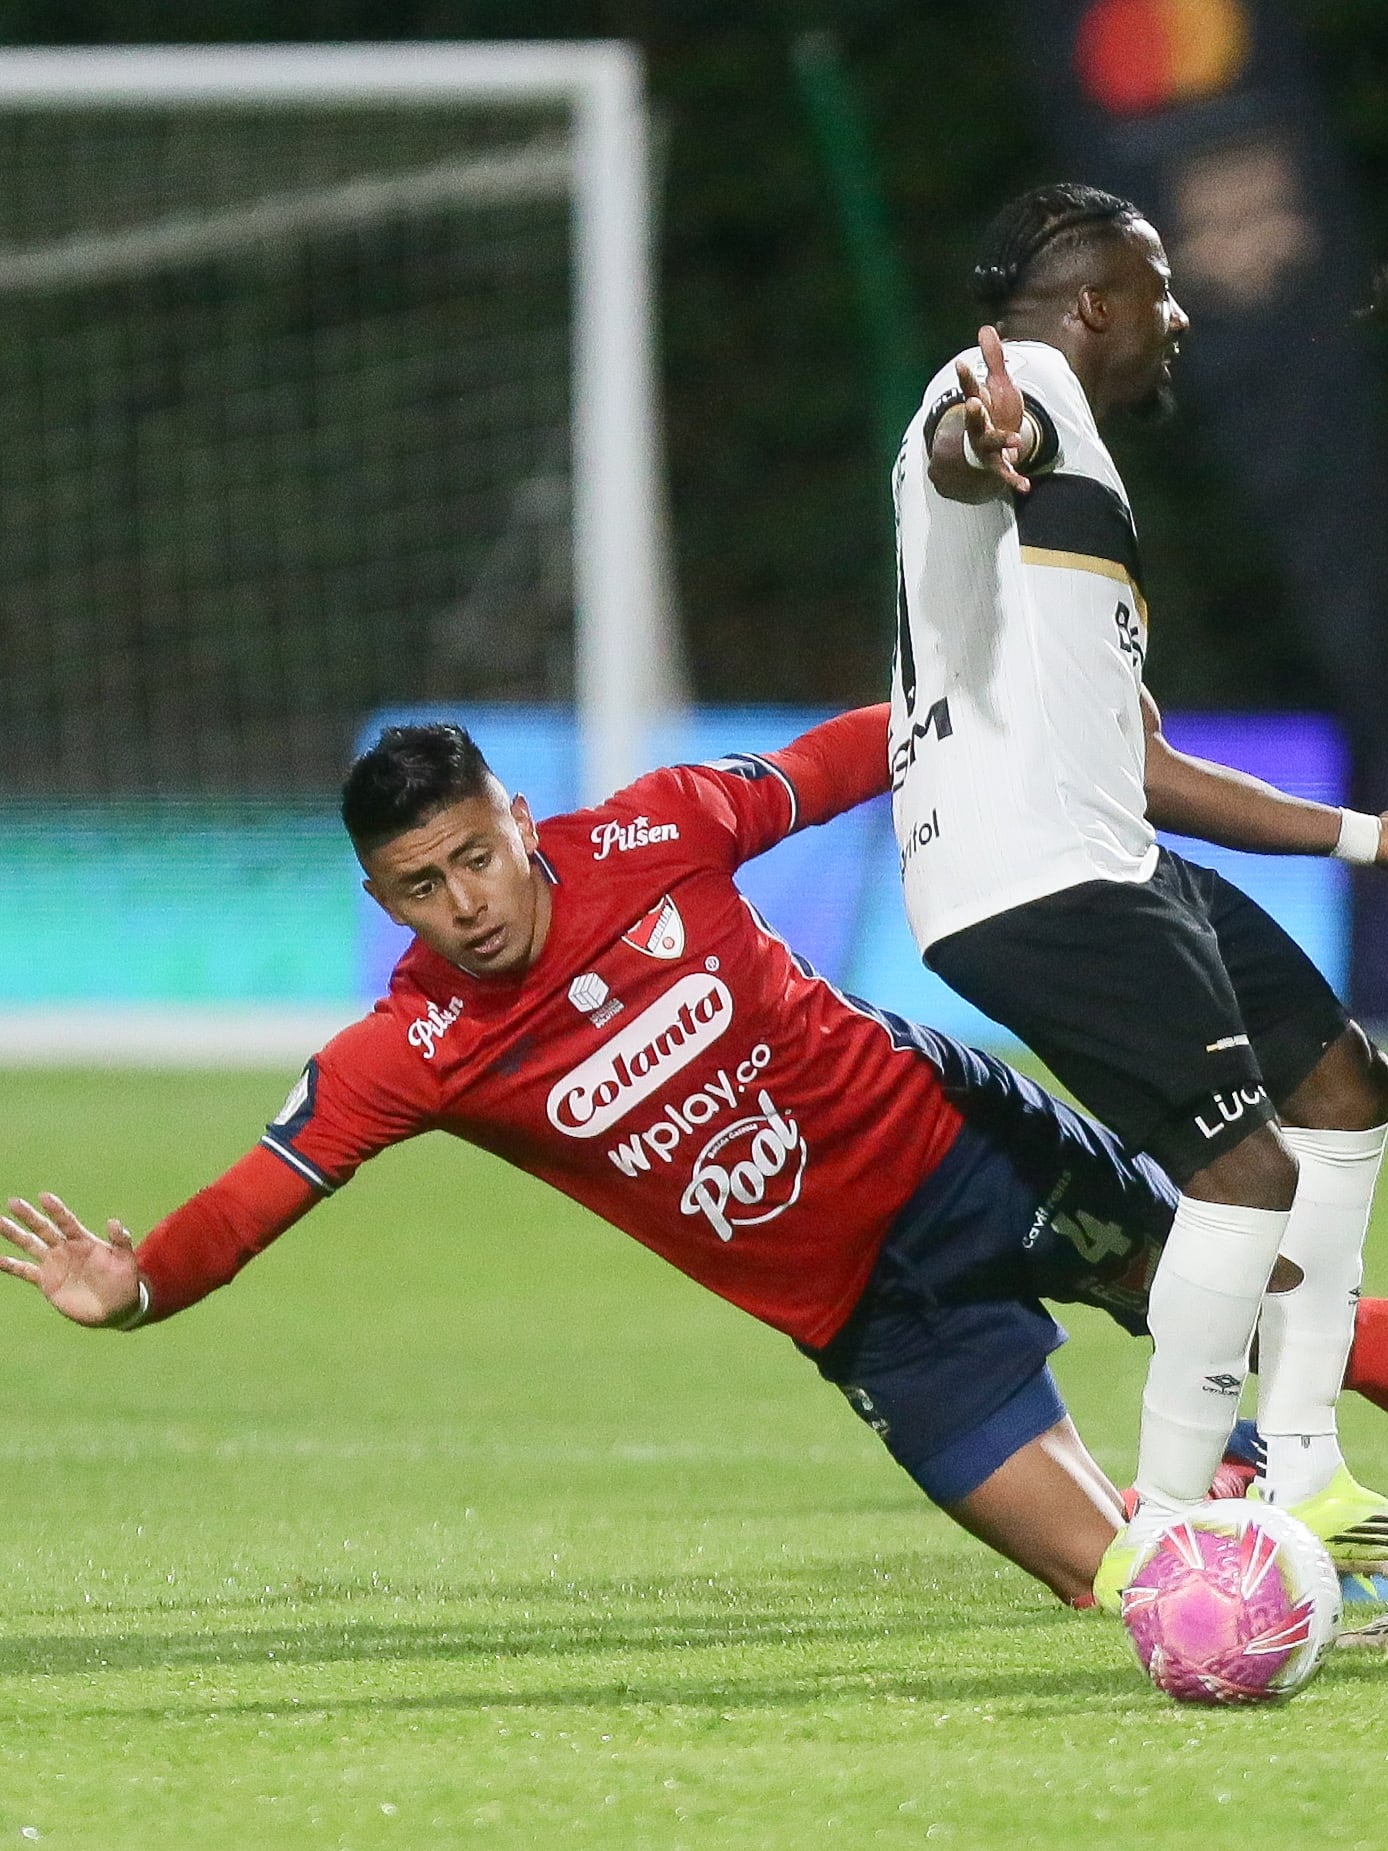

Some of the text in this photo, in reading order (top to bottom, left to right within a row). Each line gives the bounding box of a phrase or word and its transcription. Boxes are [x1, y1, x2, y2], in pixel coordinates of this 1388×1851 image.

[590, 817, 680, 861] Pilsen
[556, 985, 725, 1128] Colanta
[607, 1043, 771, 1178] wplay.co
[680, 1089, 799, 1242] Pool
[1050, 1208, 1133, 1264] 4
